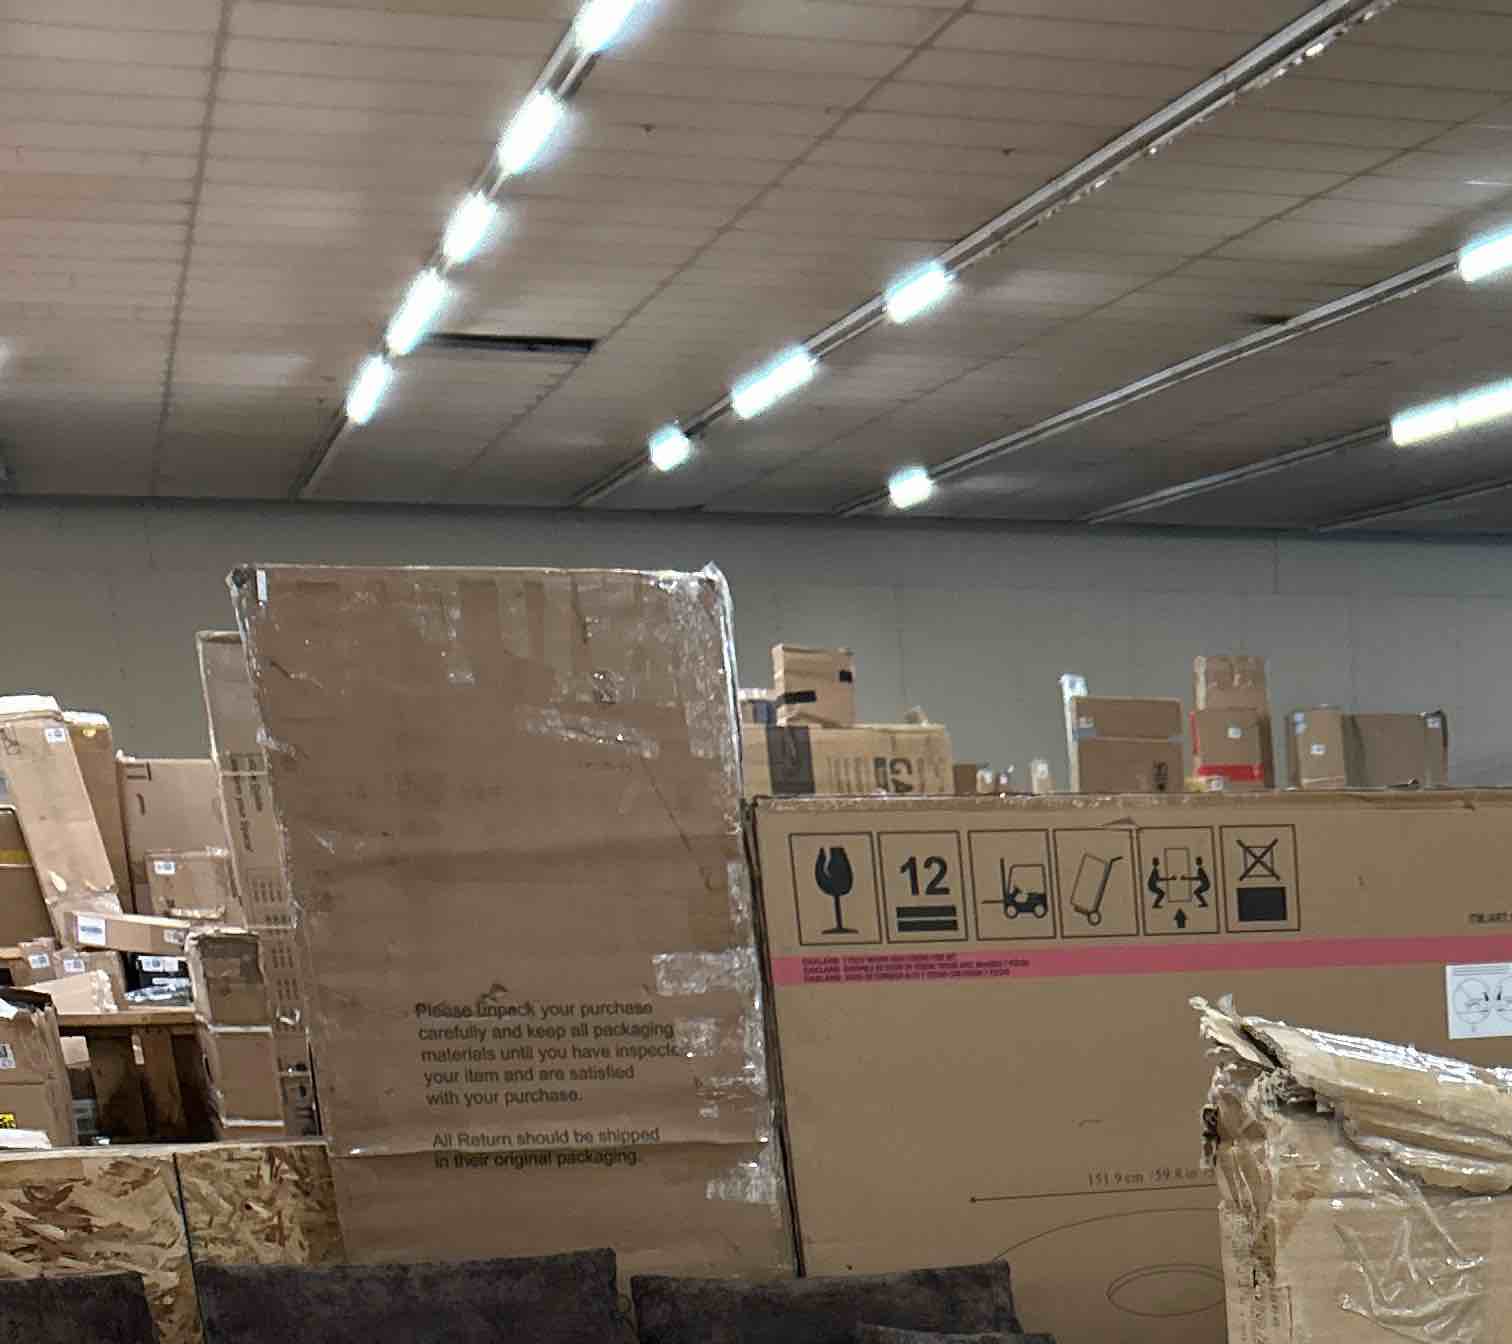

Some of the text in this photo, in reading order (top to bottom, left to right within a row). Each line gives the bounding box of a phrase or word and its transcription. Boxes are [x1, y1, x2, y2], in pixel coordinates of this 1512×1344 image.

[900, 856, 951, 897] 12
[415, 1001, 472, 1018] Please
[540, 1004, 574, 1020] your
[580, 1001, 653, 1018] purchase
[418, 1021, 675, 1042] carefully and keep all packaging
[421, 1046, 496, 1063] materials
[500, 1044, 534, 1060] until
[538, 1047, 568, 1063] you
[572, 1043, 611, 1058] have
[424, 1064, 635, 1088] your item and are satisfied
[426, 1088, 584, 1109] with your purchase.
[432, 1127, 660, 1148] All Return should be shipped
[434, 1151, 450, 1169] in
[454, 1150, 489, 1168] their
[494, 1150, 552, 1171] original
